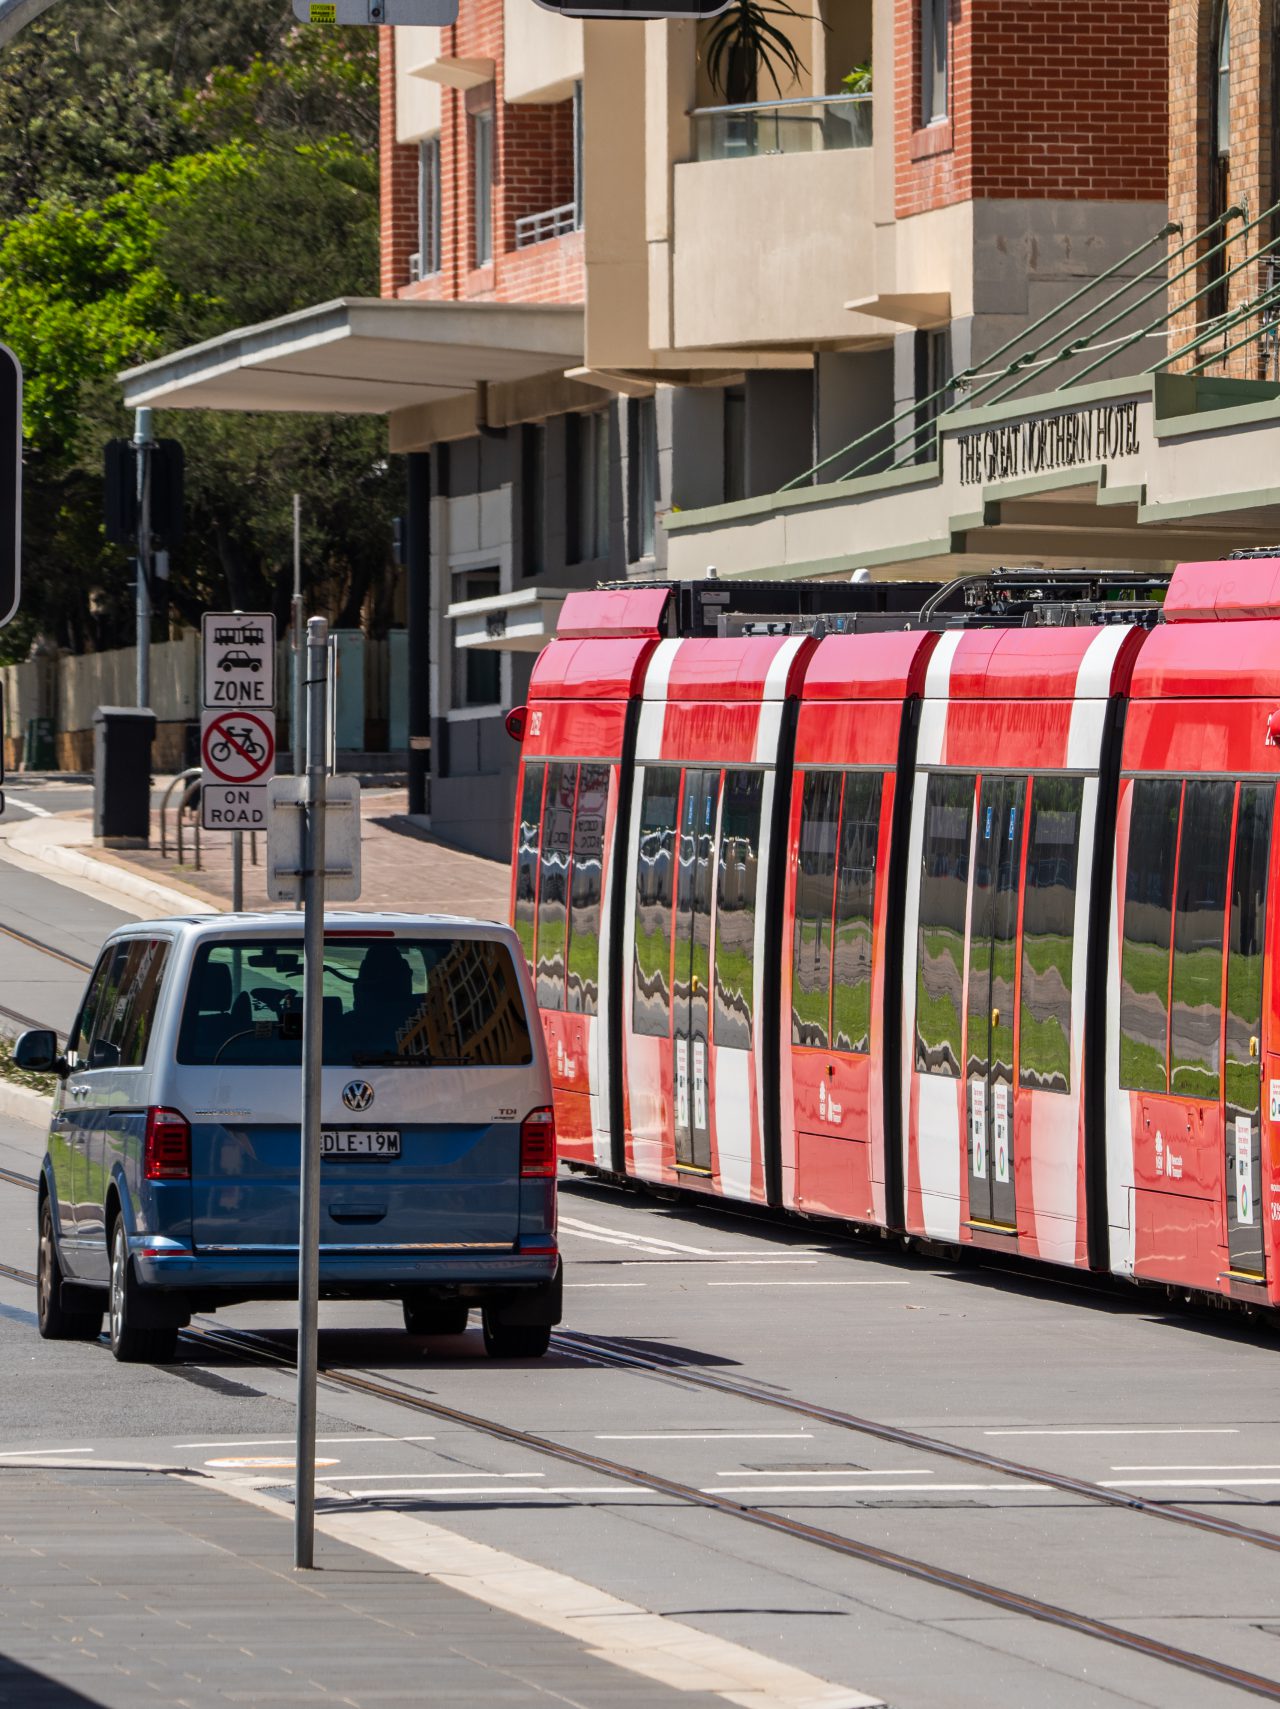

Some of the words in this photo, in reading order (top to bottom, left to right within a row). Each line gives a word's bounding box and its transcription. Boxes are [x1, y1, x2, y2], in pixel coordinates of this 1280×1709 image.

[957, 433, 983, 487] THE
[983, 424, 1021, 482] GREAT
[1021, 409, 1094, 474] NORTHERN
[1096, 401, 1140, 459] HOTEL
[213, 680, 265, 702] ZONE
[224, 790, 250, 805] ON
[210, 809, 264, 823] ROAD
[498, 1107, 518, 1116] TDI
